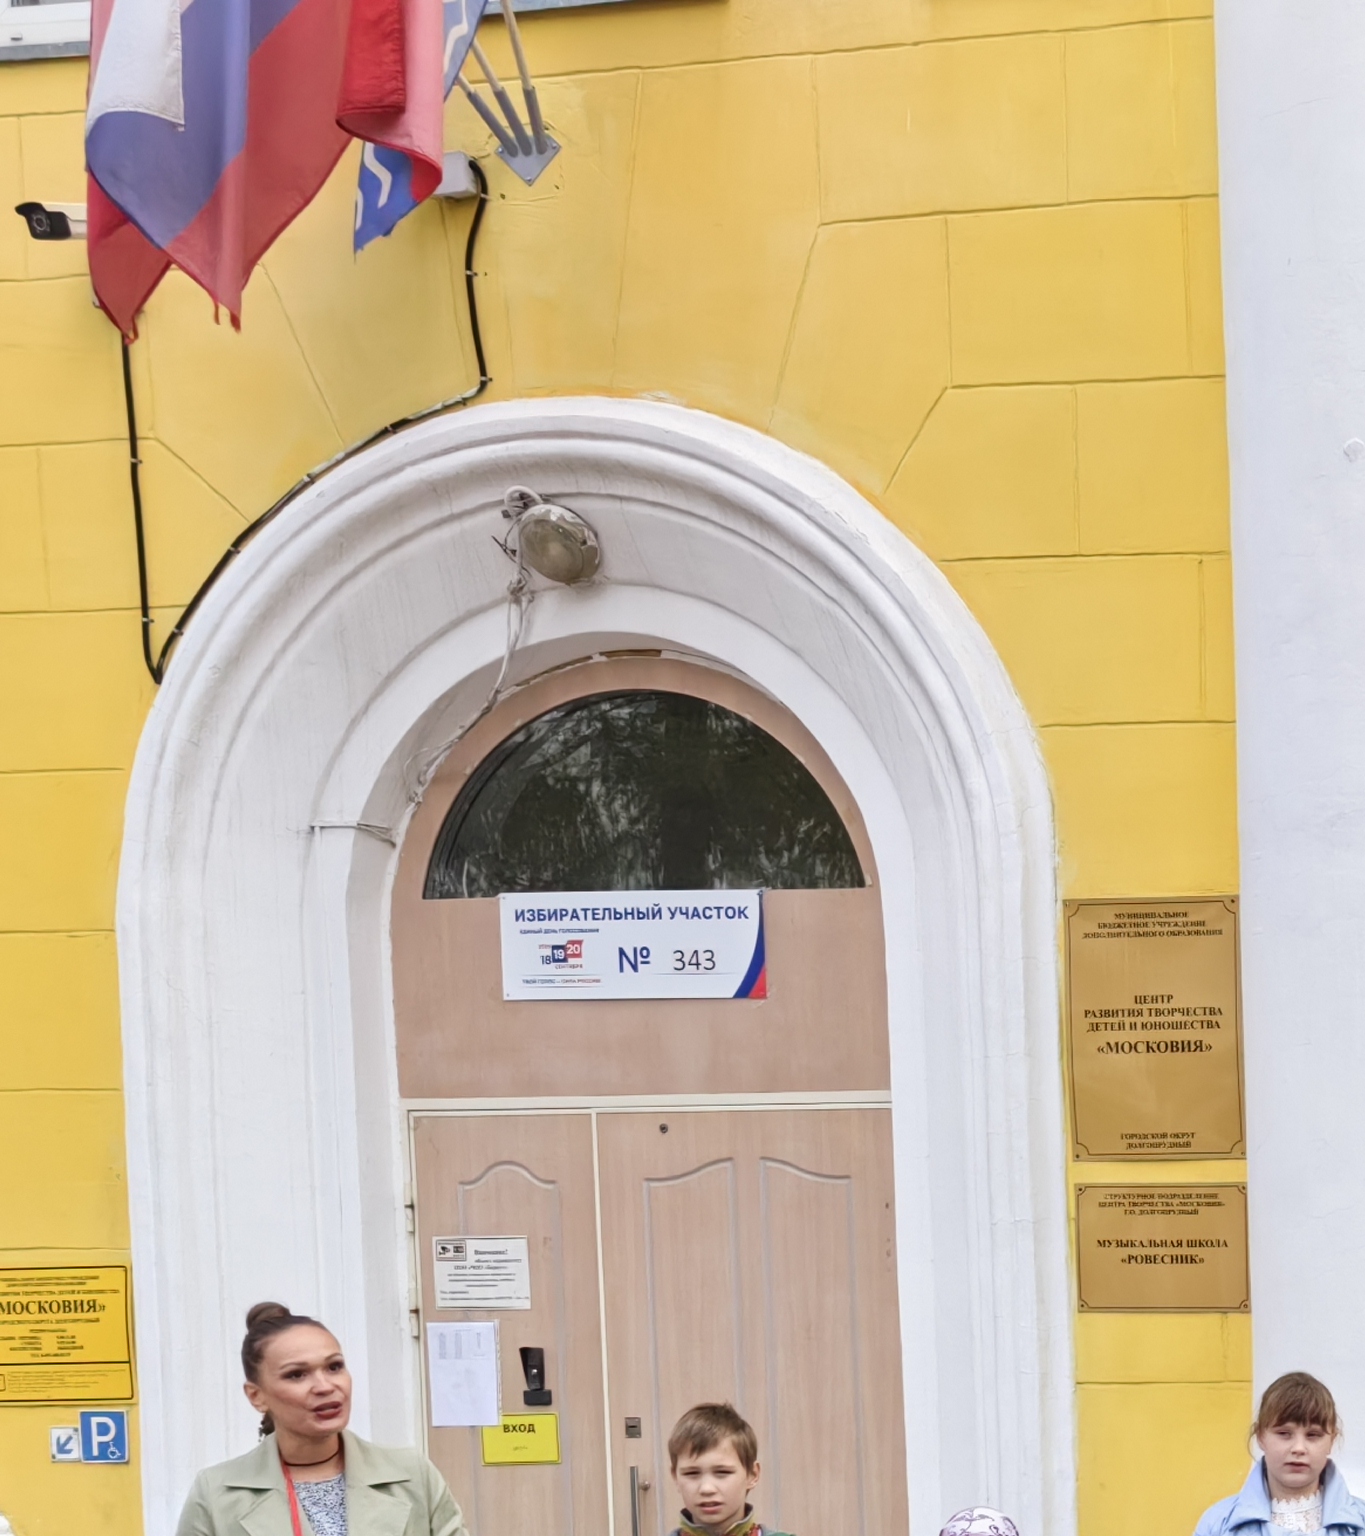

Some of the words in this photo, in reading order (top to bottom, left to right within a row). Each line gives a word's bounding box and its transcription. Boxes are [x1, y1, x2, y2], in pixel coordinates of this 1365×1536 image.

[514, 903, 663, 923] ИЗБИРАТЕЛЬНЫЙ
[667, 905, 749, 921] УЧАСТОК
[1114, 911, 1189, 920] МУНИЦИПАЛЬНОЕ
[1097, 921, 1150, 930] БЮДЖЕТНОЕ
[1152, 920, 1206, 928] УЧРЕЖДЕНИЕ
[1166, 929, 1223, 937] ОБРАЗОВАНИЯ
[553, 949, 565, 960] 19
[566, 944, 580, 954] 20
[540, 955, 552, 965] 18
[618, 946, 651, 973] №
[672, 949, 717, 971] 343
[1134, 994, 1174, 1005] ЦЕНТР
[1084, 1008, 1144, 1019] РАЗВИТИЯ
[1147, 1006, 1223, 1017] ТВОРЧЕСТВА
[1086, 1019, 1126, 1033] ДЕТЕЙ
[1129, 1021, 1138, 1031] И
[1141, 1020, 1221, 1031] ЮНОШЕСТВА
[1097, 1039, 1213, 1054] «МОСКОВИЯ»
[1120, 1132, 1168, 1140] ГОРОДСКОЙ
[1169, 1131, 1196, 1139] ОКРУГ
[1126, 1140, 1192, 1150] ДОЛГОПРУДНЫЙ
[1096, 1239, 1183, 1249] МУЗЫКАЛЬНАЯ
[1186, 1239, 1229, 1248] ШКОЛА
[1121, 1253, 1205, 1265] «РОВЕСНИК»
[503, 1423, 536, 1434] ВХОД
